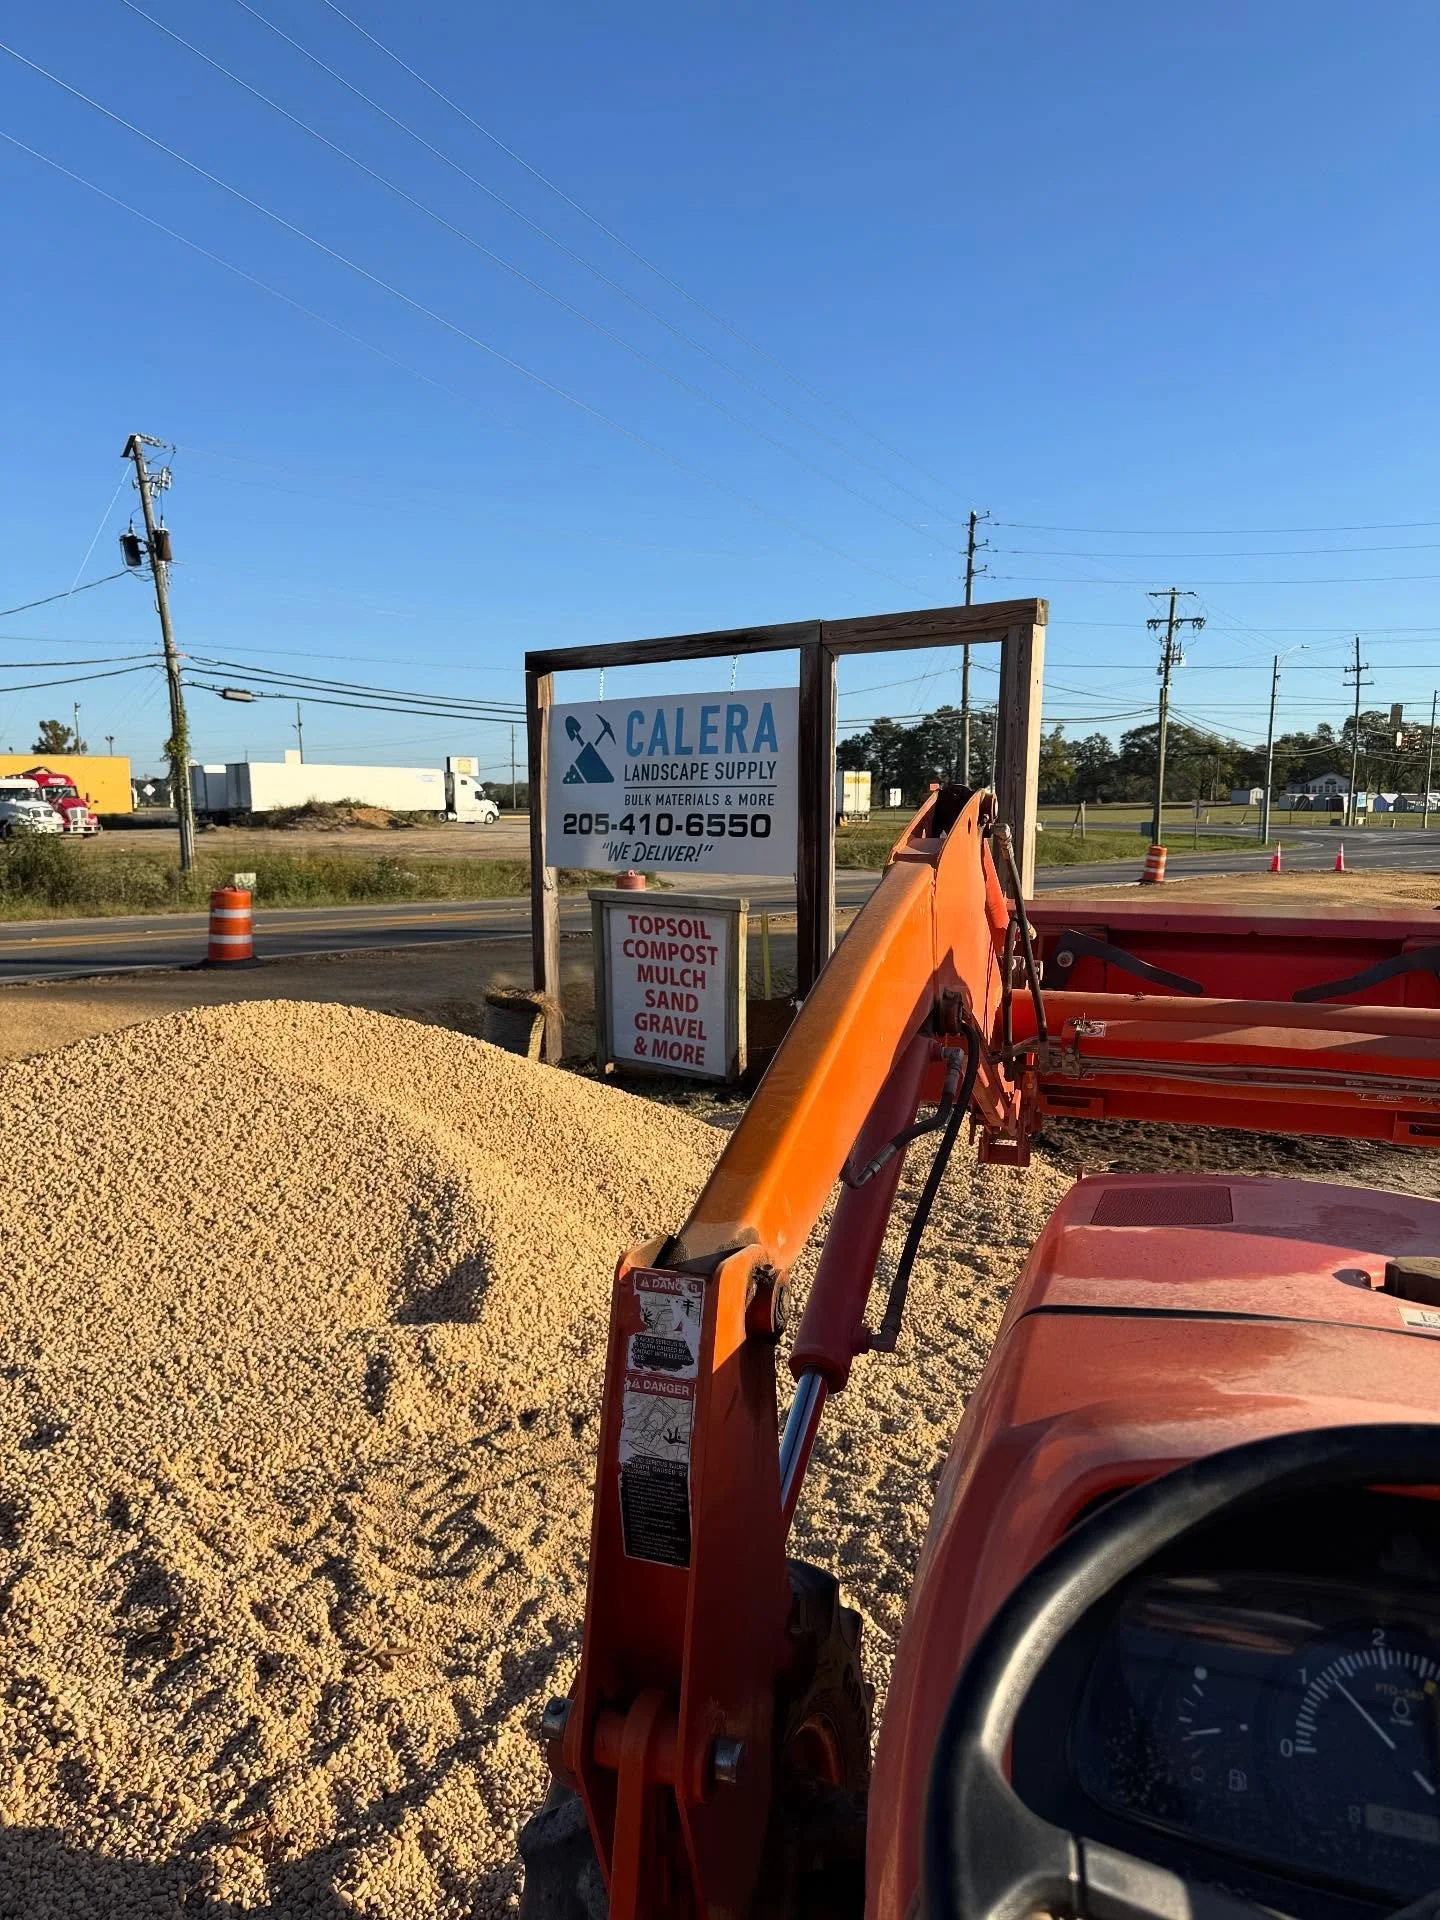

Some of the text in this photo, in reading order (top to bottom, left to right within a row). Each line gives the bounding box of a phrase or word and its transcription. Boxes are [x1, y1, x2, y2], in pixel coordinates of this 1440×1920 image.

[626, 702, 778, 757] CALERA
[624, 761, 777, 782] LANDSCAPE SUPPLY
[624, 793, 774, 806] BULK MATERIALS & MORE
[563, 813, 771, 838] 205-410-6550
[628, 915, 711, 940] TOPSOIL
[623, 939, 718, 966] COMPOST
[637, 964, 706, 989] MULCH
[645, 989, 699, 1013] SAND
[635, 1012, 707, 1040] GRAVEL
[634, 1036, 705, 1065] & MORE
[644, 1380, 690, 1396] DANGER
[1372, 1628, 1385, 1646] 2
[1297, 1667, 1308, 1685] 1
[1280, 1738, 1294, 1758] 0
